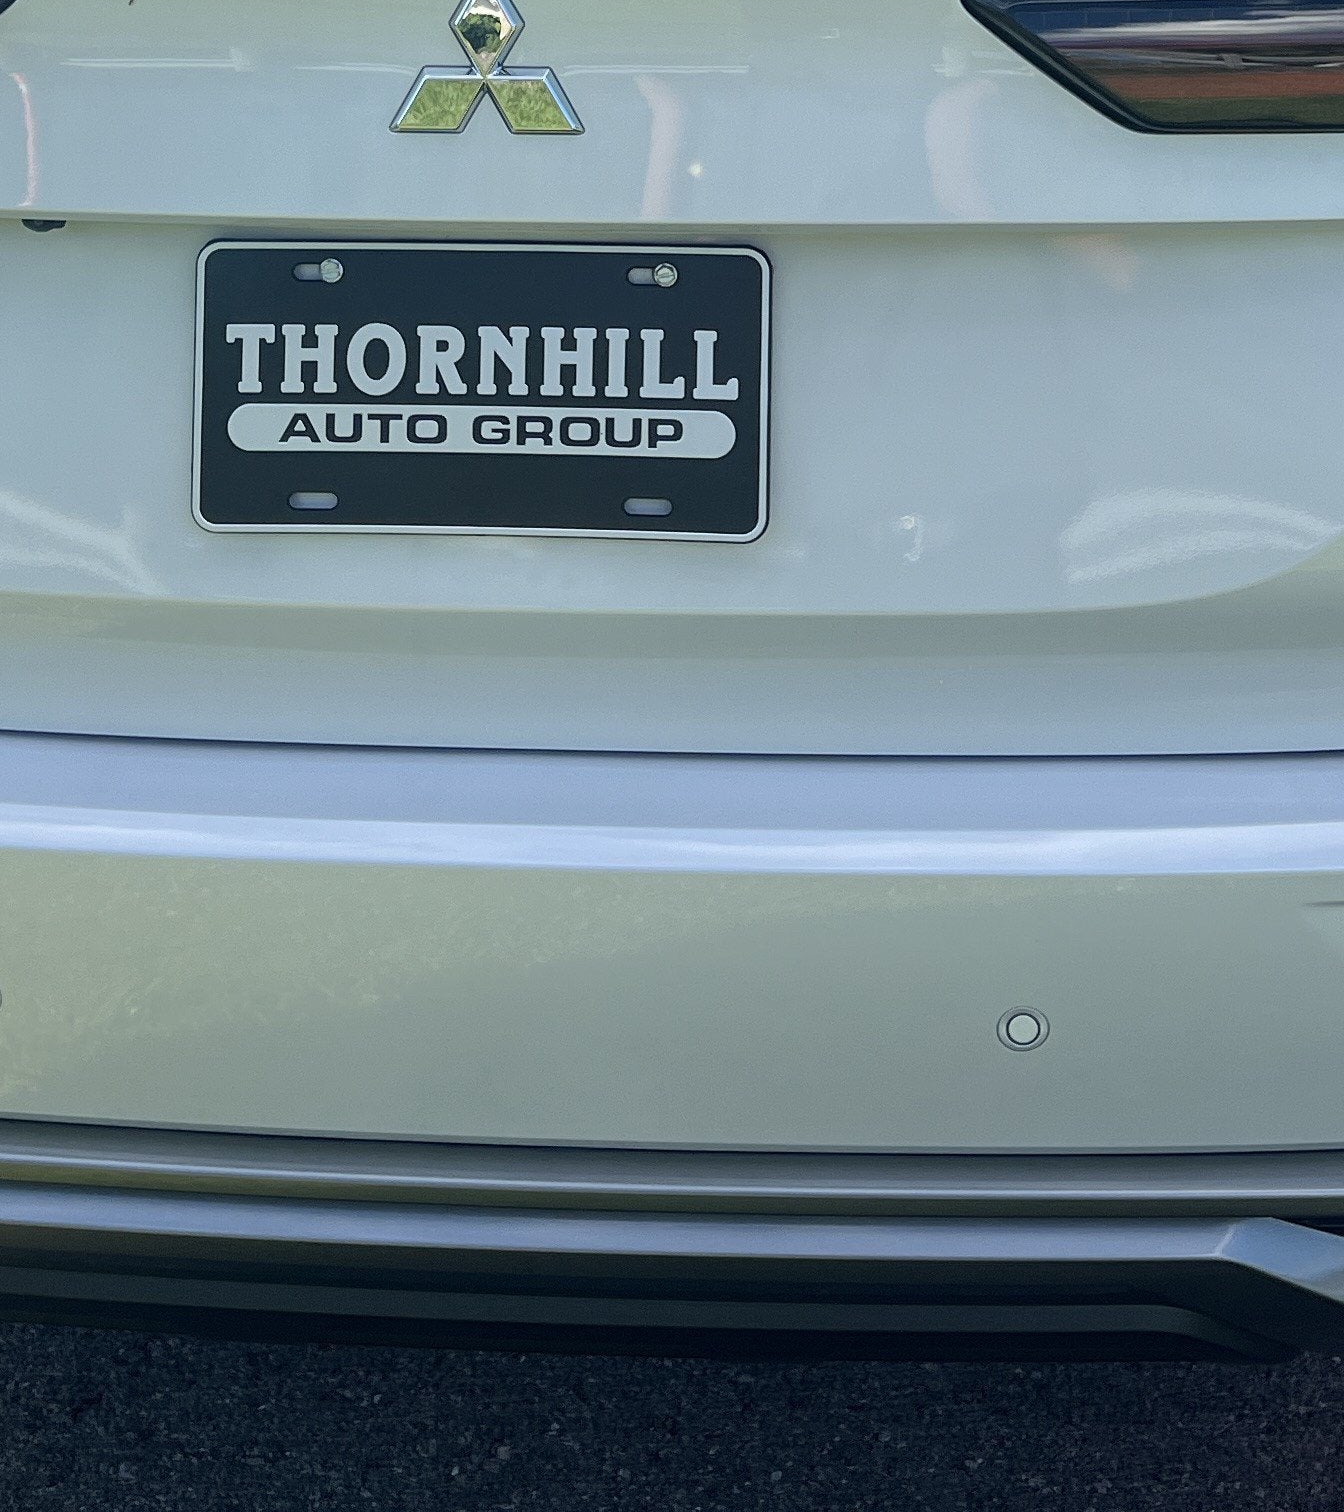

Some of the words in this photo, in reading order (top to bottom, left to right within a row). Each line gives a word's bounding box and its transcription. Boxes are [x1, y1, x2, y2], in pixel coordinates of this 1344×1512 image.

[225, 322, 740, 401] THORNHILL
[278, 412, 449, 445] AUTO
[471, 414, 684, 449] GROUP
